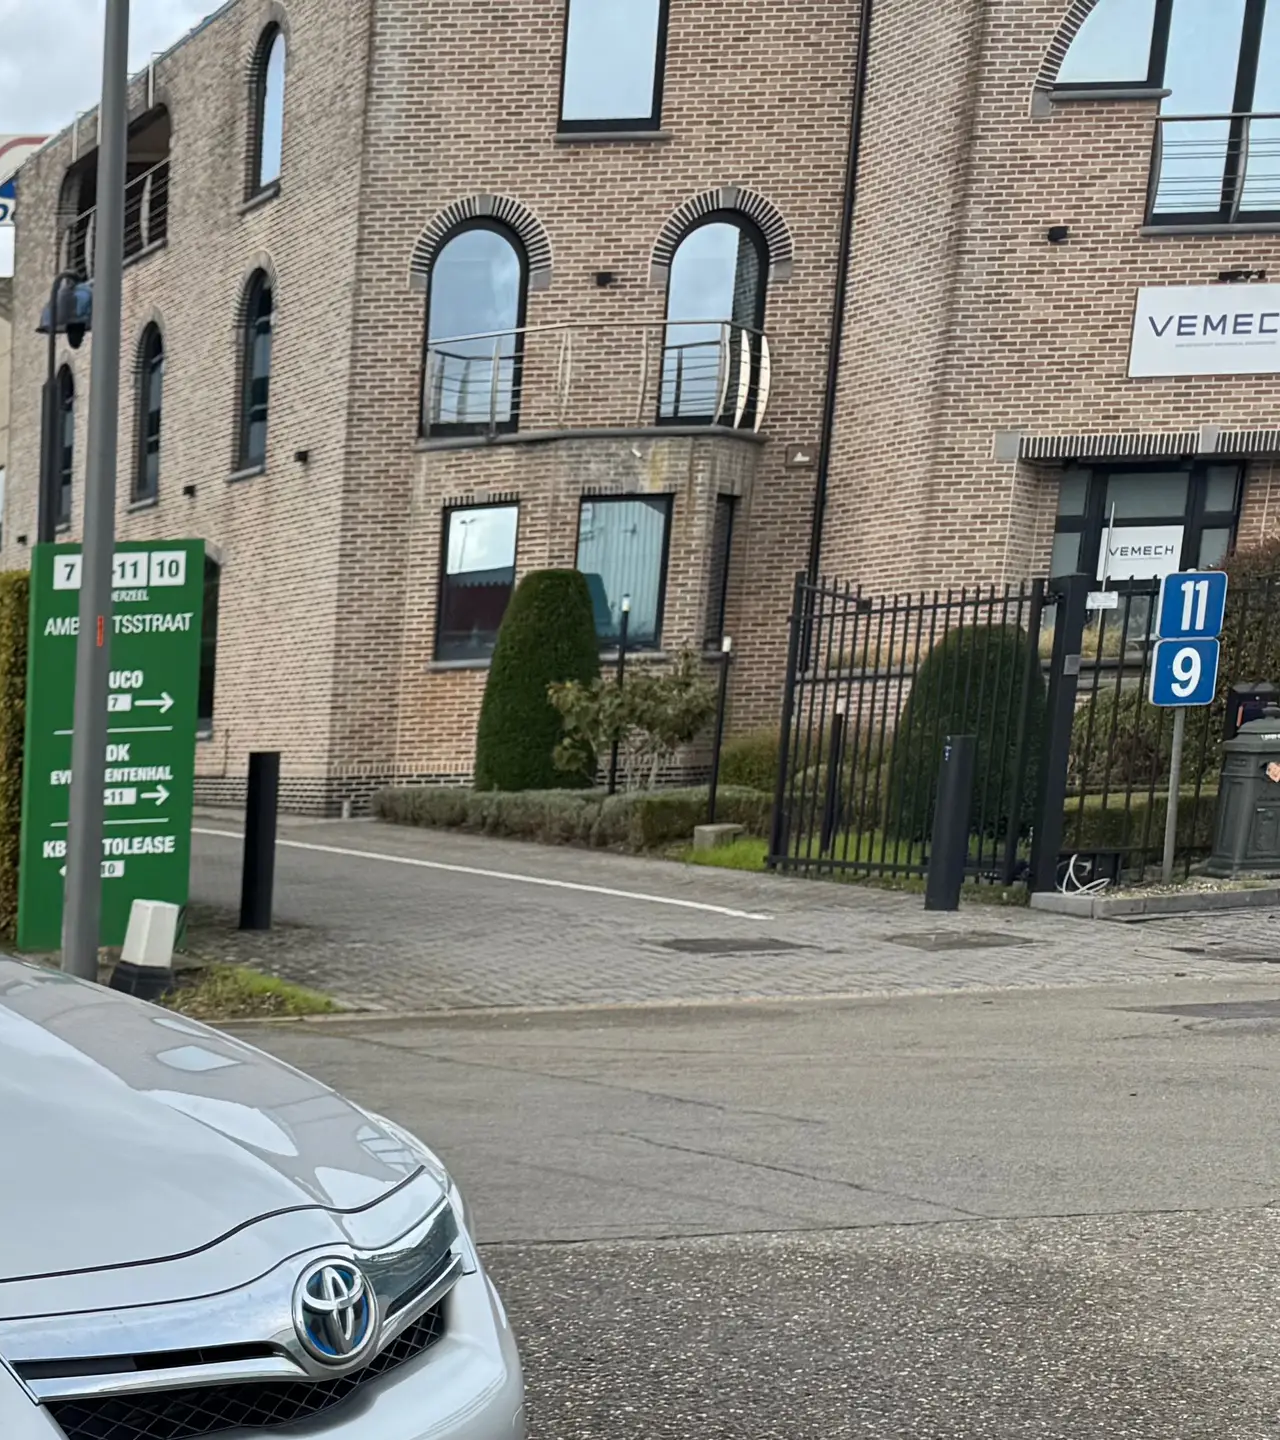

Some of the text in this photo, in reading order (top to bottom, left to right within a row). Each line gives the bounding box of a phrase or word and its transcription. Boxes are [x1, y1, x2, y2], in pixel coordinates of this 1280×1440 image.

[1148, 312, 1280, 337] VEMEC
[1109, 544, 1175, 557] VEMECH
[63, 563, 76, 581] 7
[156, 560, 180, 578] 10
[1181, 580, 1209, 630] 11
[44, 612, 194, 636] AMBTSSTRAAT
[108, 669, 144, 689] UCO
[1171, 647, 1201, 697] 9
[111, 697, 119, 709] 7
[105, 743, 130, 762] DK
[43, 835, 175, 858] KB TOLEASE
